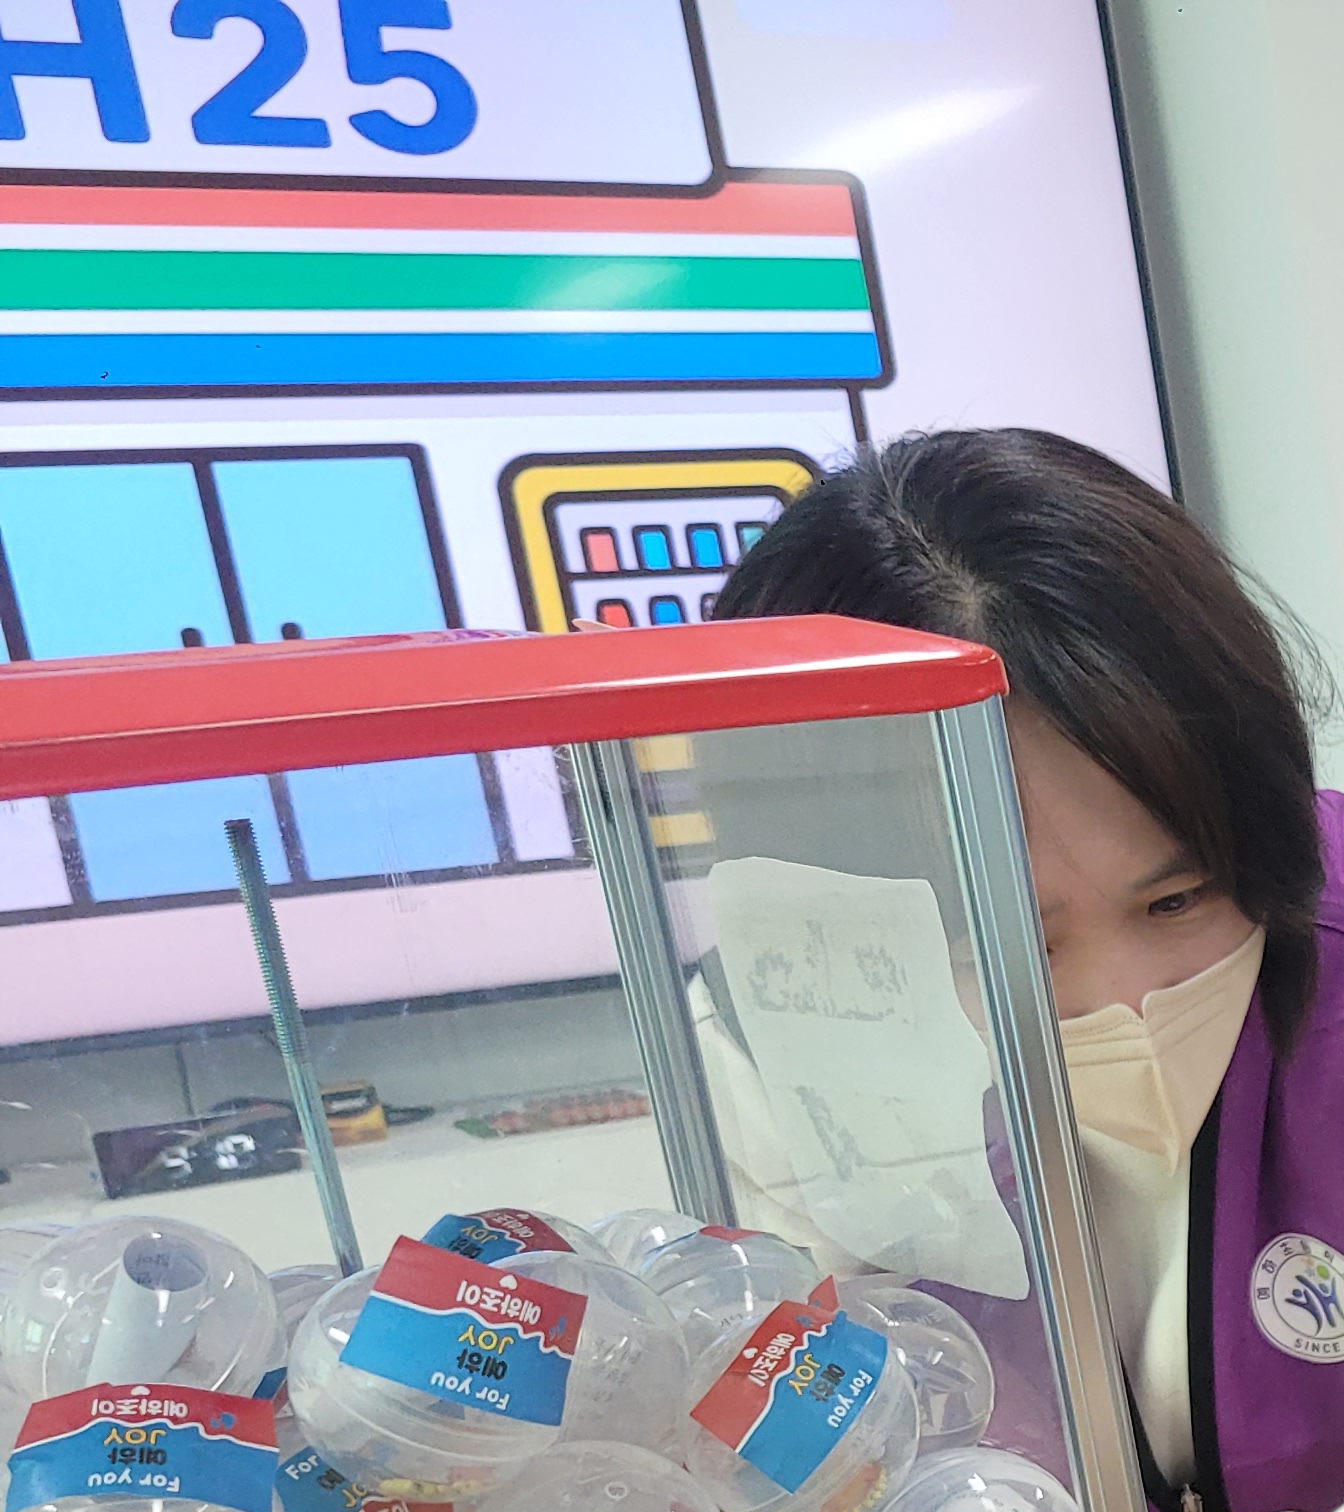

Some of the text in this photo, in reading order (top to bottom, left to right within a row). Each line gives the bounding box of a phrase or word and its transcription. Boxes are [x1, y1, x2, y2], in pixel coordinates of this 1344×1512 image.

[460, 1225, 499, 1244] JOY
[456, 1280, 541, 1325] 예하조이
[458, 1324, 514, 1354] JOY
[1295, 1338, 1340, 1353] SINCE
[456, 1349, 508, 1380] 예하
[747, 1332, 796, 1387] 예하조이
[788, 1353, 821, 1396] JOY
[430, 1372, 510, 1411] For you
[827, 1369, 873, 1428] For you
[91, 1398, 188, 1418] 예하조이
[104, 1427, 167, 1446] JOY
[107, 1448, 167, 1465] 예하
[285, 1455, 319, 1480] For
[88, 1467, 180, 1492] For you
